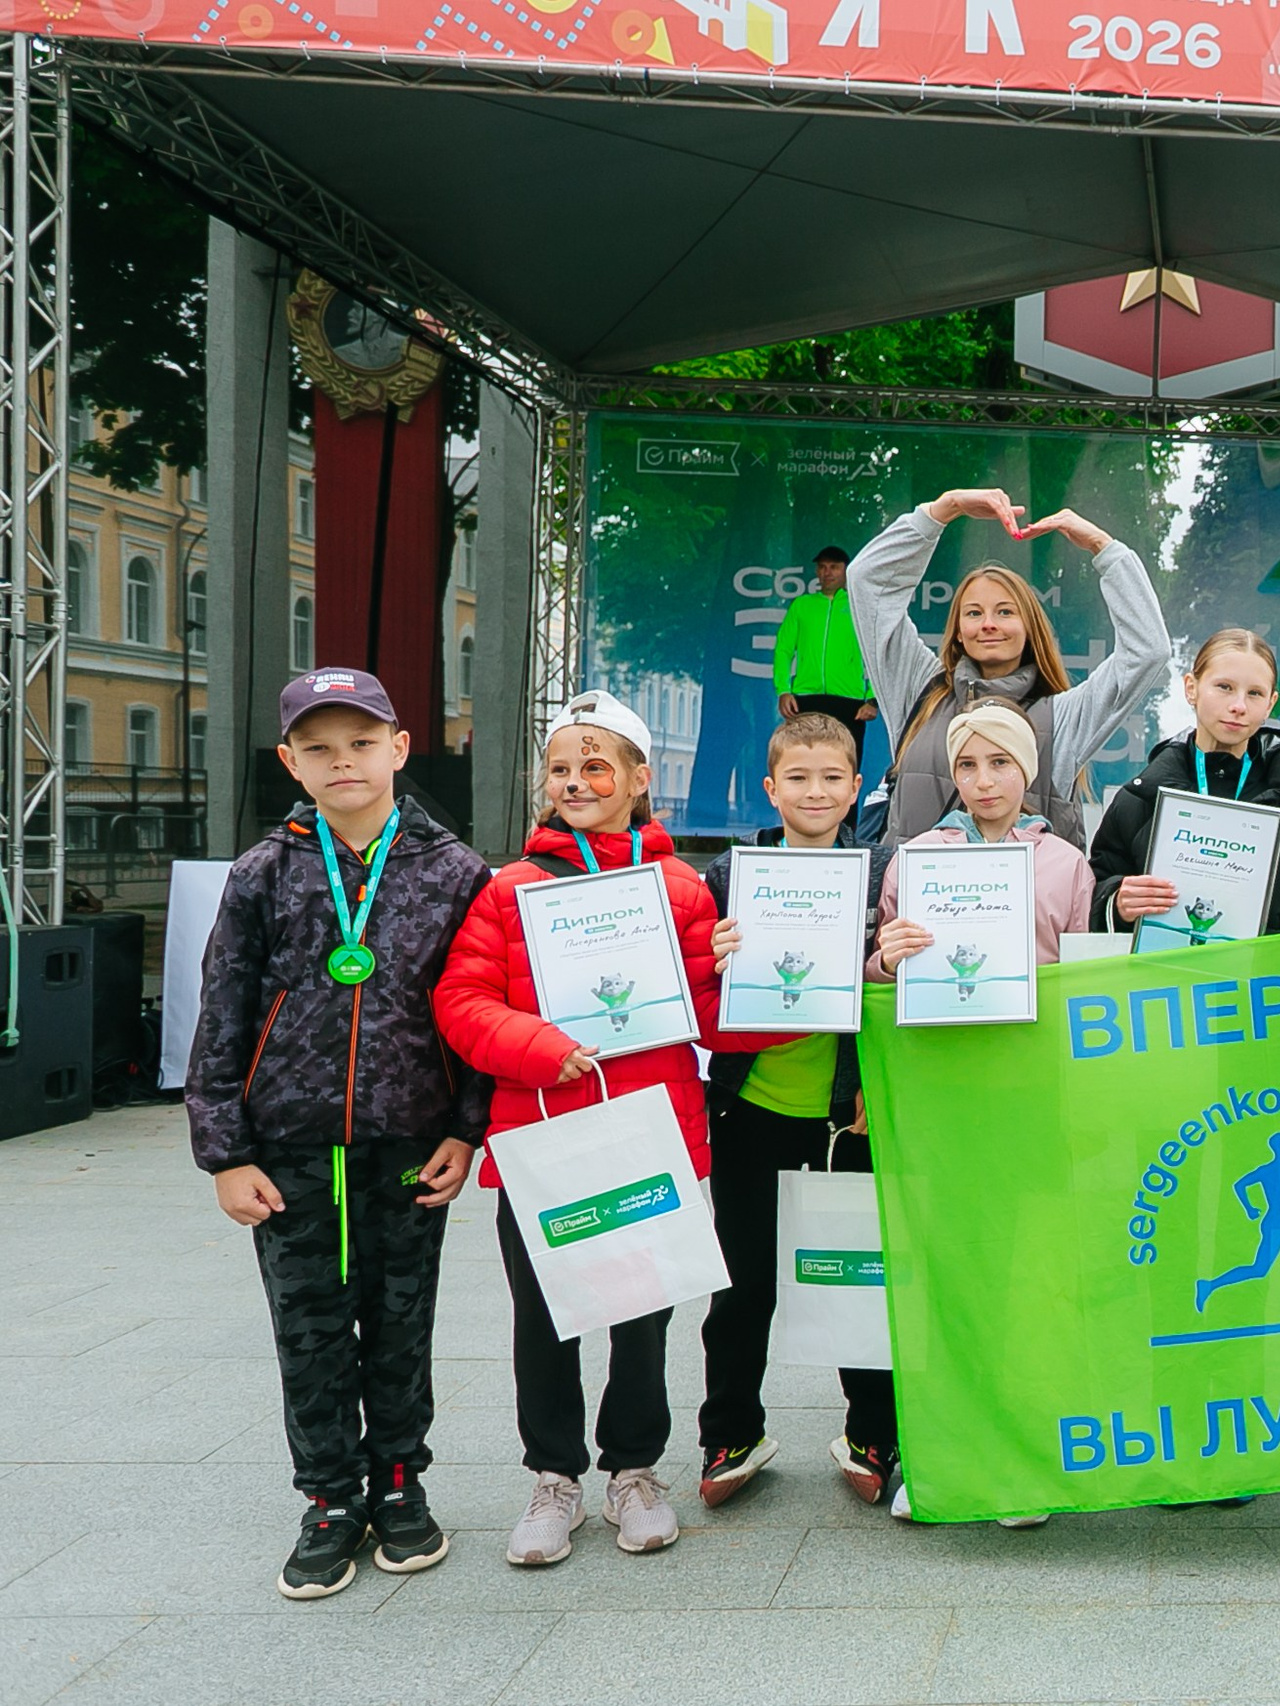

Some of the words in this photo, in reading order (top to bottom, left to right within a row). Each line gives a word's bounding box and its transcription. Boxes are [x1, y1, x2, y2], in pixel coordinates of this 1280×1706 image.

[1067, 14, 1222, 68] 2026
[668, 448, 724, 466] Прайм
[786, 446, 855, 461] зелёный
[777, 460, 849, 476] марафон
[1173, 829, 1256, 855] Диплом
[753, 886, 841, 900] Диплом
[921, 882, 1009, 895] Диплом
[550, 907, 644, 933] Диплом
[616, 1198, 651, 1214] марафон
[618, 1189, 652, 1207] зелёный
[564, 1214, 592, 1230] Прайм
[813, 1264, 837, 1273] Прайм
[858, 1267, 884, 1275] марафо
[1058, 1405, 1175, 1472] ВЫ
